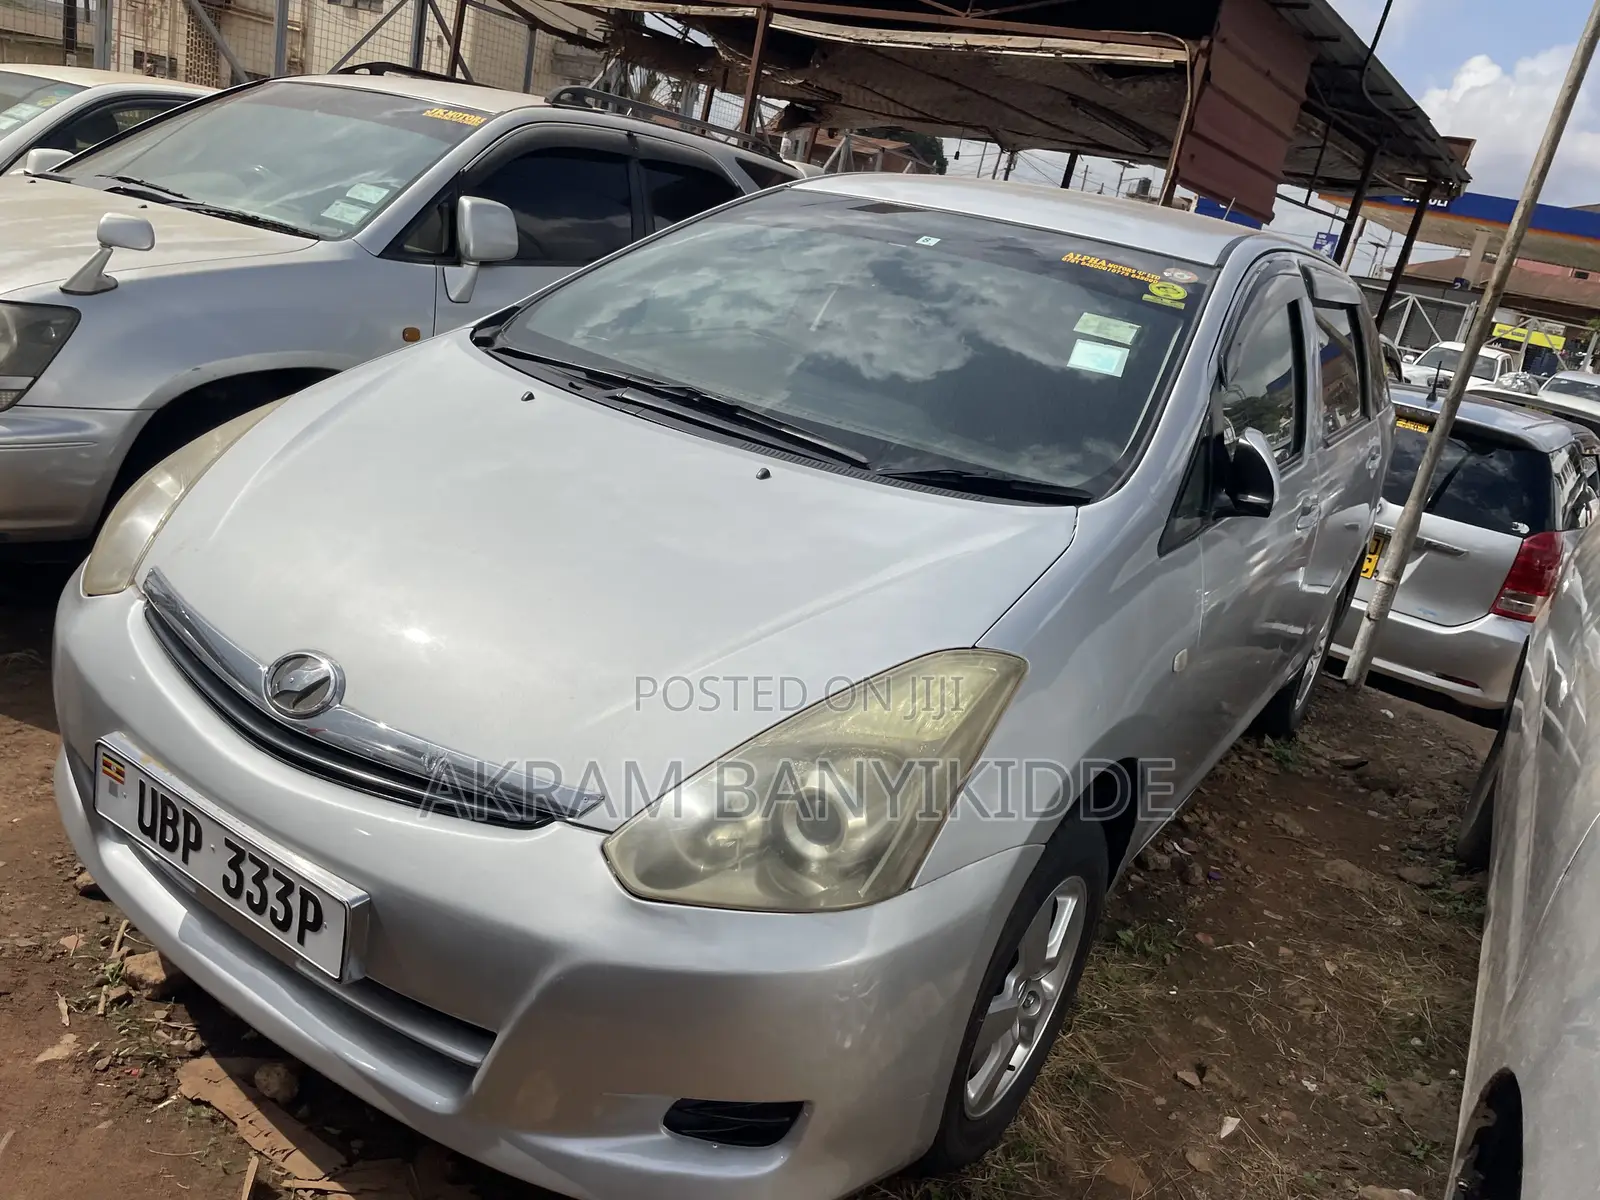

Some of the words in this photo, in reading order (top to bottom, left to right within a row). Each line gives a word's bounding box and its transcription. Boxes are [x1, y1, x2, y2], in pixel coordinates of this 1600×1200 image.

[1063, 252, 1107, 267] ALPHA
[1107, 263, 1136, 274] MOTORS
[1147, 272, 1160, 280] LTD
[137, 778, 203, 866] UBP
[222, 836, 324, 948] 333P
